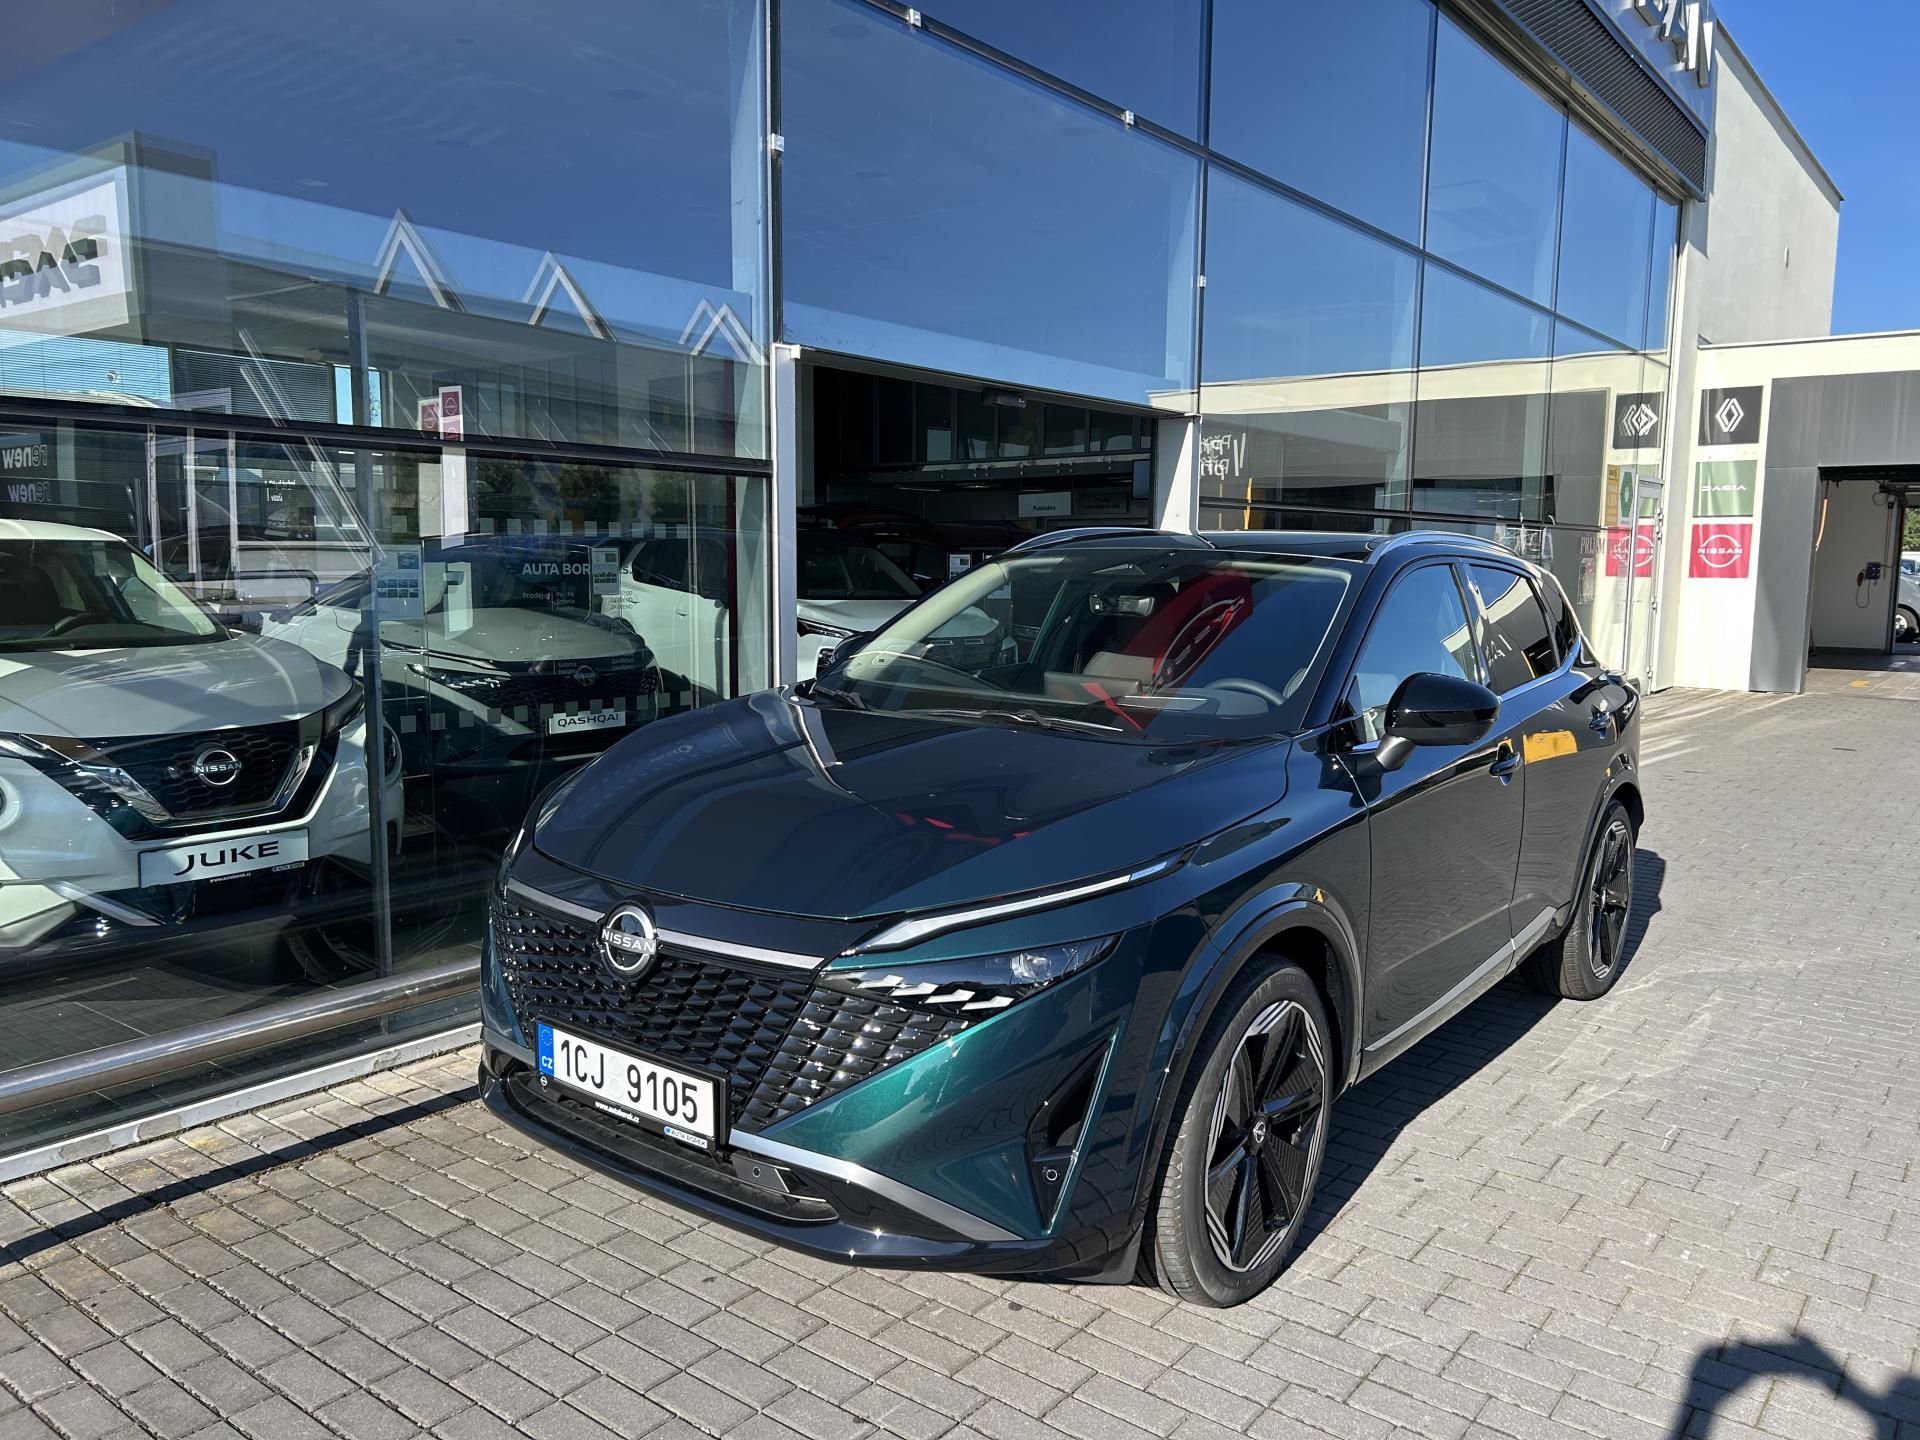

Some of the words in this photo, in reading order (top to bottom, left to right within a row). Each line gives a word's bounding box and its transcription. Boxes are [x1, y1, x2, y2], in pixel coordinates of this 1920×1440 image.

[522, 563, 559, 575] AUTA
[562, 563, 590, 575] BOR
[557, 713, 619, 727] QASHQAI
[195, 762, 242, 773] NISSAN
[173, 840, 280, 876] JUKE
[601, 928, 656, 953] NISSAN
[541, 1056, 553, 1069] CZ
[561, 1039, 604, 1089] 1CJ
[626, 1064, 698, 1123] 9105
[671, 1129, 686, 1139] AUTA
[686, 1135, 706, 1147] BOREK
